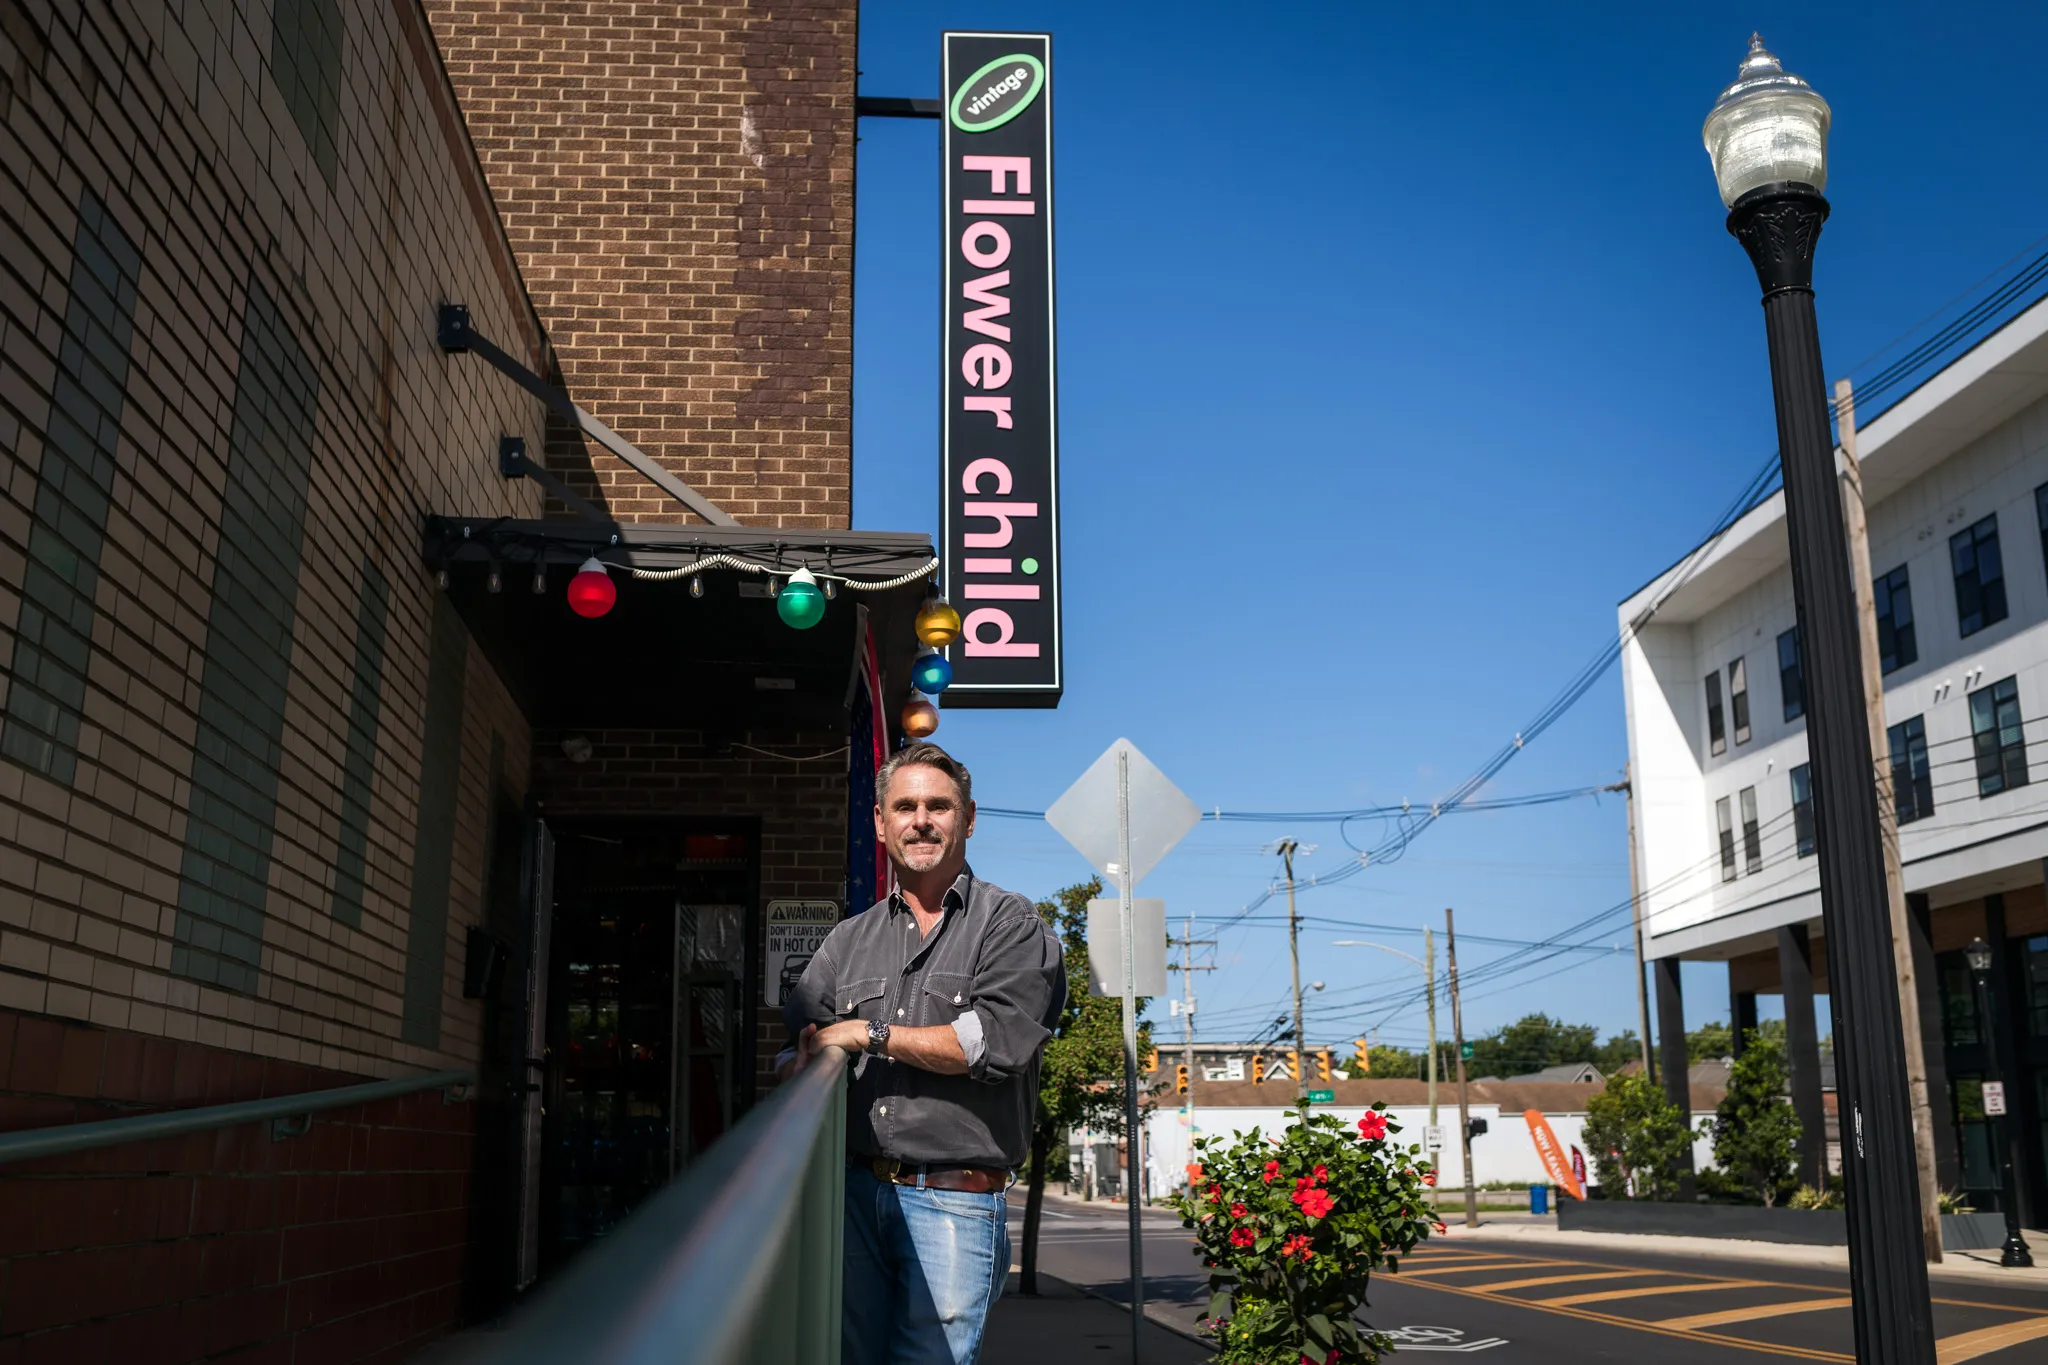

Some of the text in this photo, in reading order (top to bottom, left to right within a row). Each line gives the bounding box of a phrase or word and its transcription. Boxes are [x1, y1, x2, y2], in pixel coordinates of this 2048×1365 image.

[966, 67, 1028, 116] vintage
[961, 155, 1041, 659] Flower child
[785, 906, 834, 921] WARNING
[770, 925, 792, 936] DON'T
[793, 925, 814, 937] LEAVE
[770, 938, 824, 952] IN HOT CA
[1534, 1126, 1551, 1151] NOW
